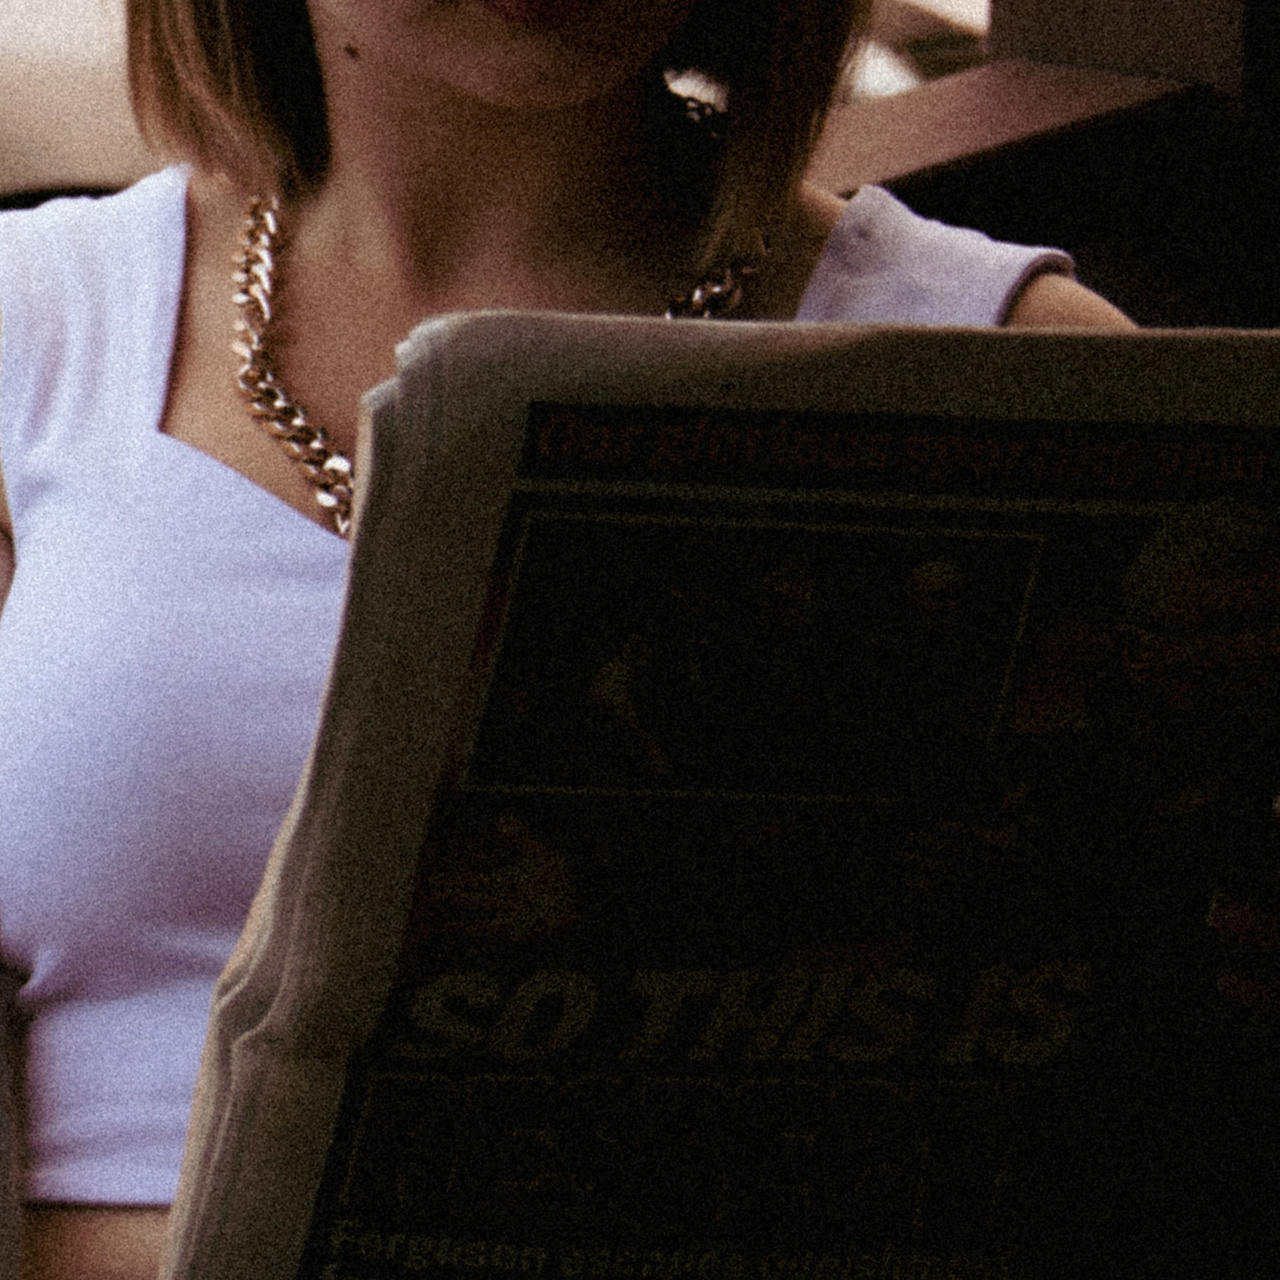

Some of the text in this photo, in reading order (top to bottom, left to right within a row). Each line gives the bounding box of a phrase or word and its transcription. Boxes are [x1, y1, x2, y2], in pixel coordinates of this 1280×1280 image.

[395, 961, 1094, 1066] SO THIS IS
